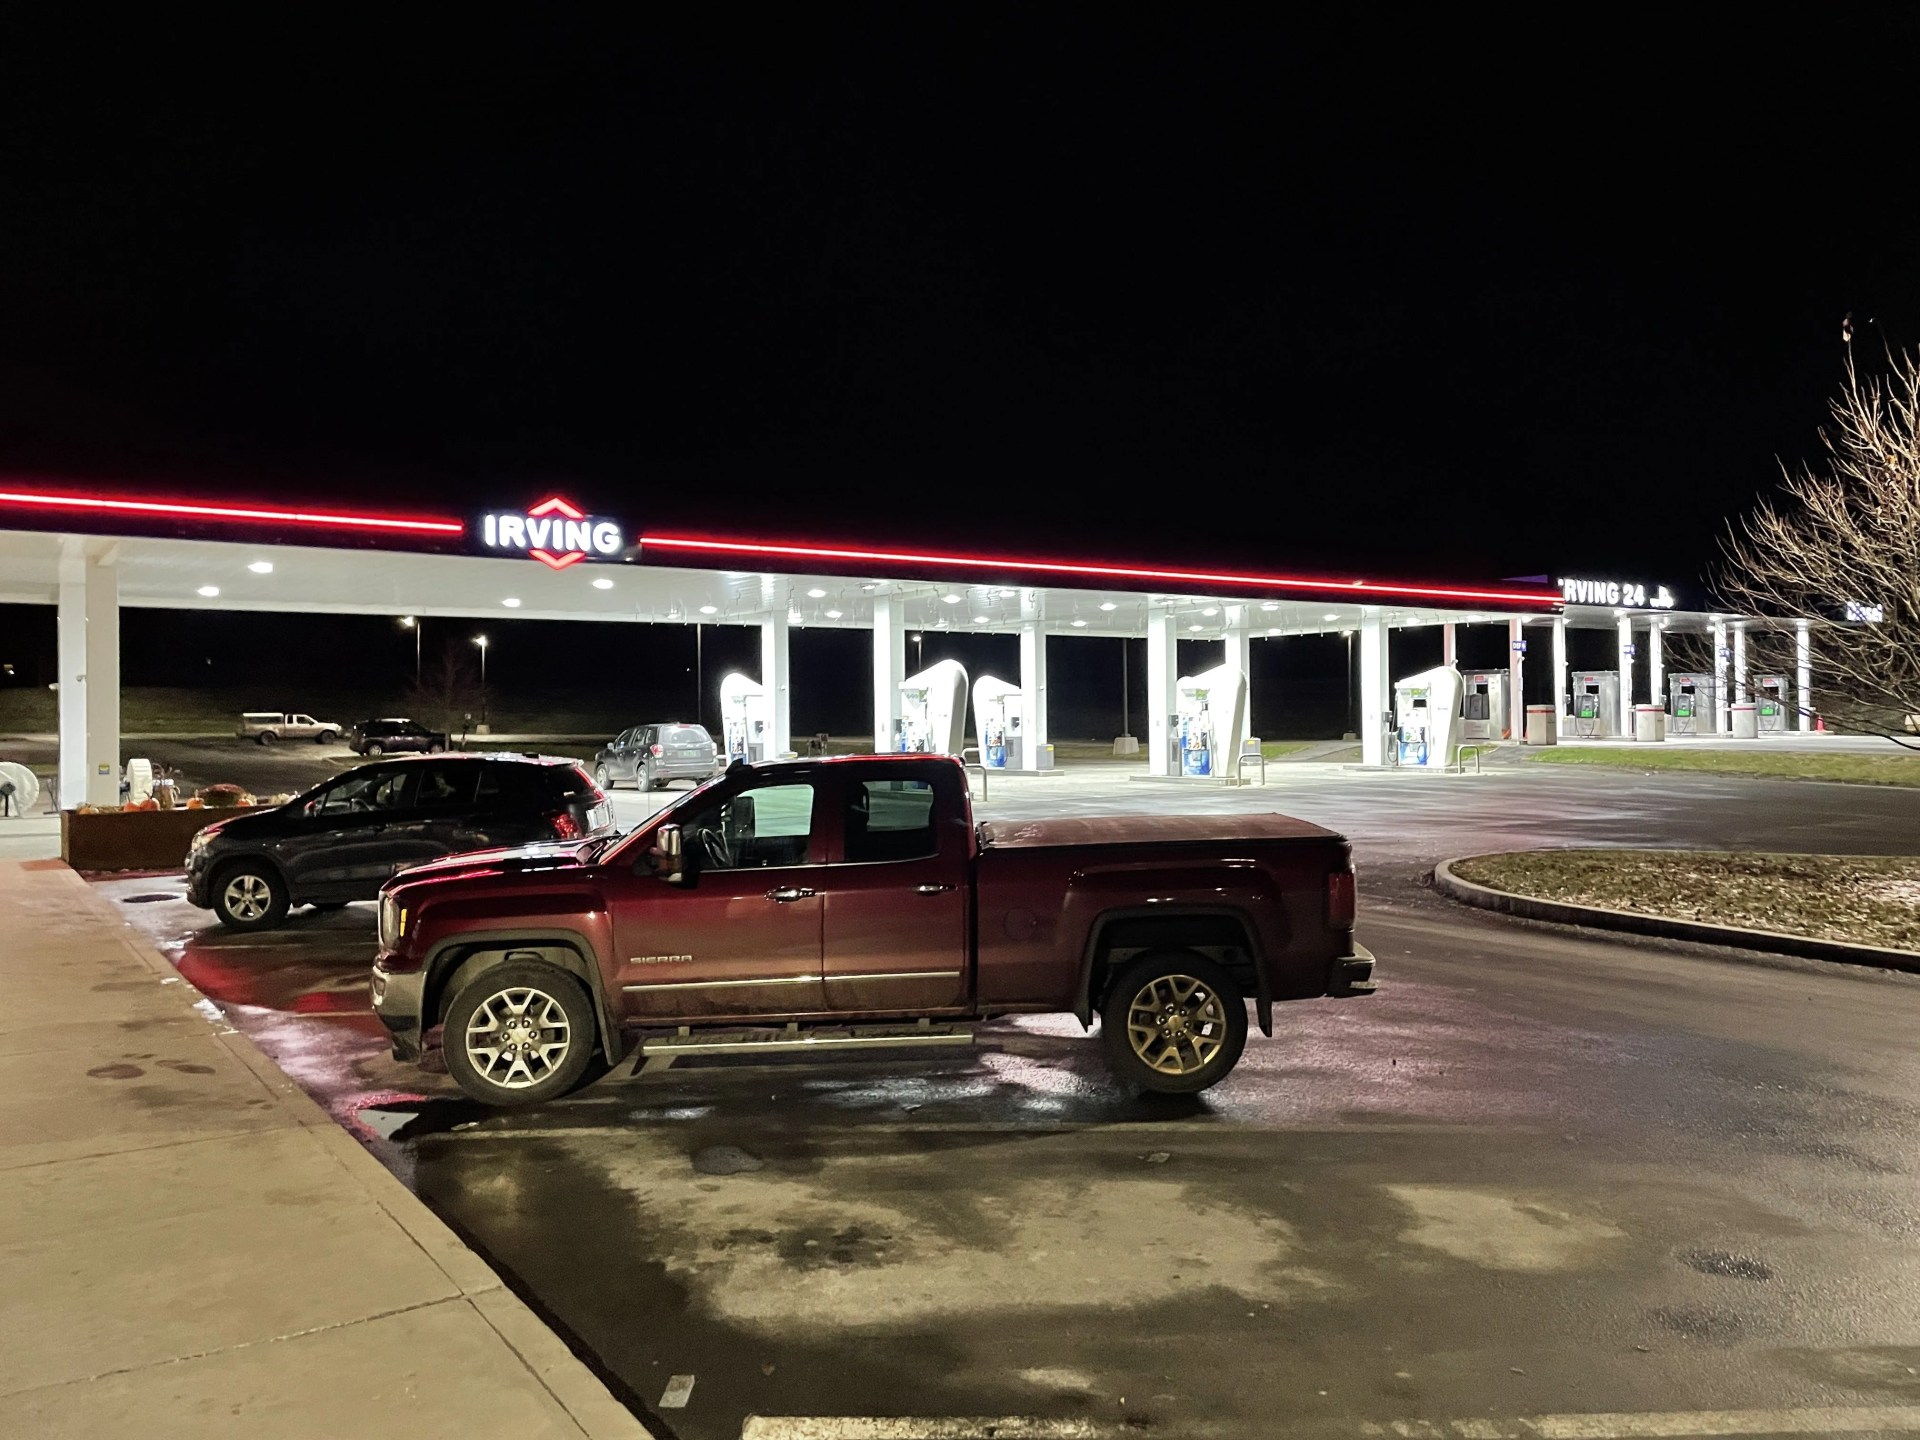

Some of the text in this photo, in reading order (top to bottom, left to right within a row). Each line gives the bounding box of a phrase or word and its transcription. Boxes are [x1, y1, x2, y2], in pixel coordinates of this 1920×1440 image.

[485, 514, 620, 553] IRVING
[1622, 584, 1645, 606] 24
[630, 955, 692, 964] SIERRA
